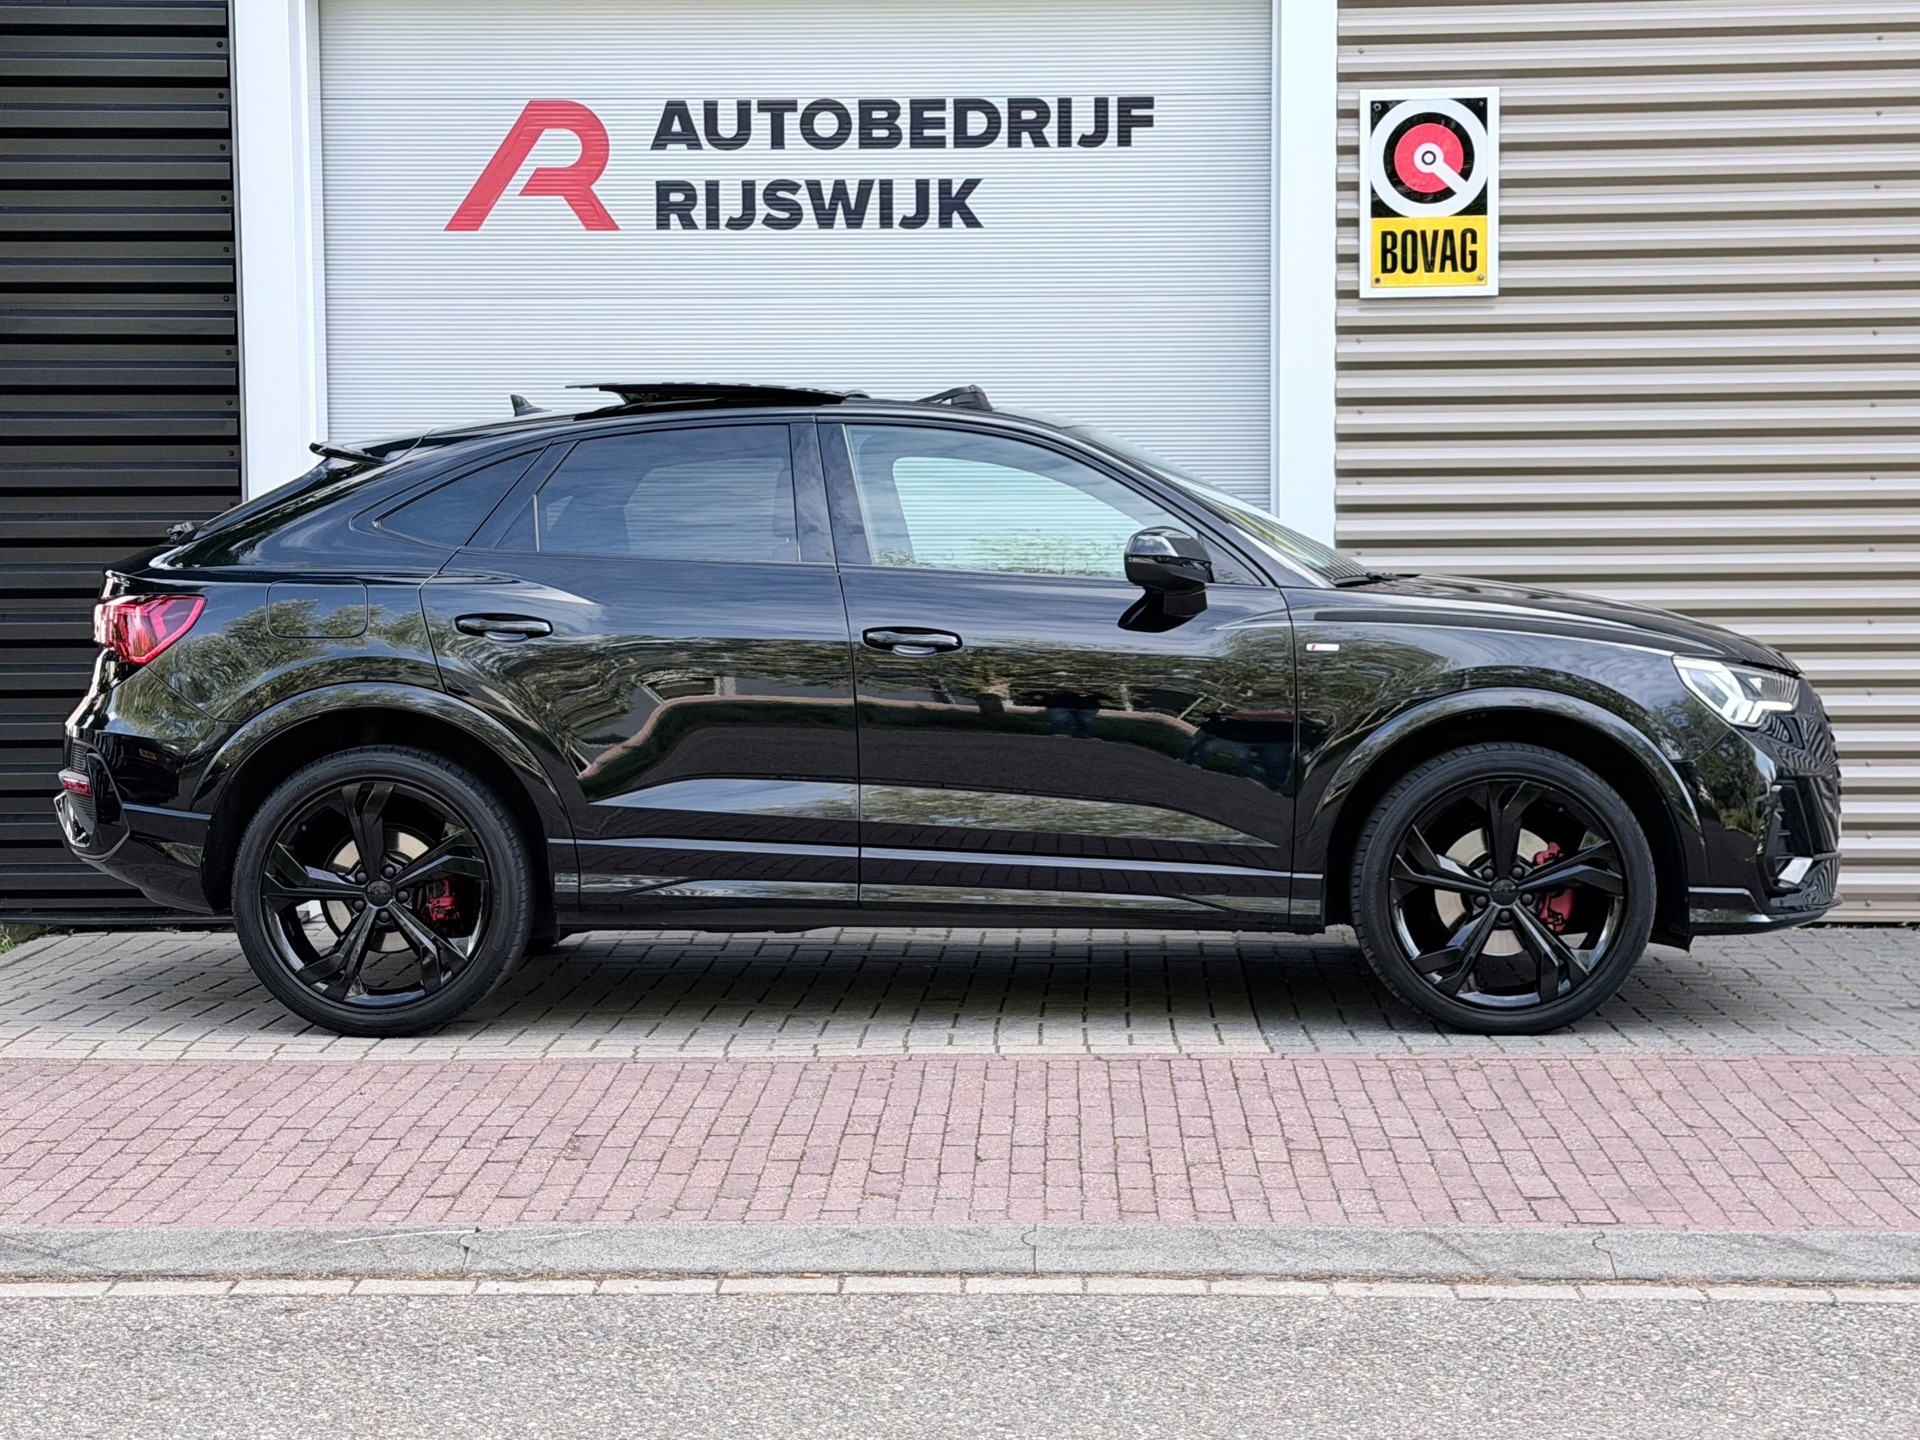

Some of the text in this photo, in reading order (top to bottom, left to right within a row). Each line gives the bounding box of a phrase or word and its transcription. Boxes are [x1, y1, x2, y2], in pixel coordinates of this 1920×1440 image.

[651, 96, 1154, 150] AUTOBEDRIJF
[656, 178, 983, 231] RIJSWIJK
[1380, 228, 1478, 274] BOVAG
